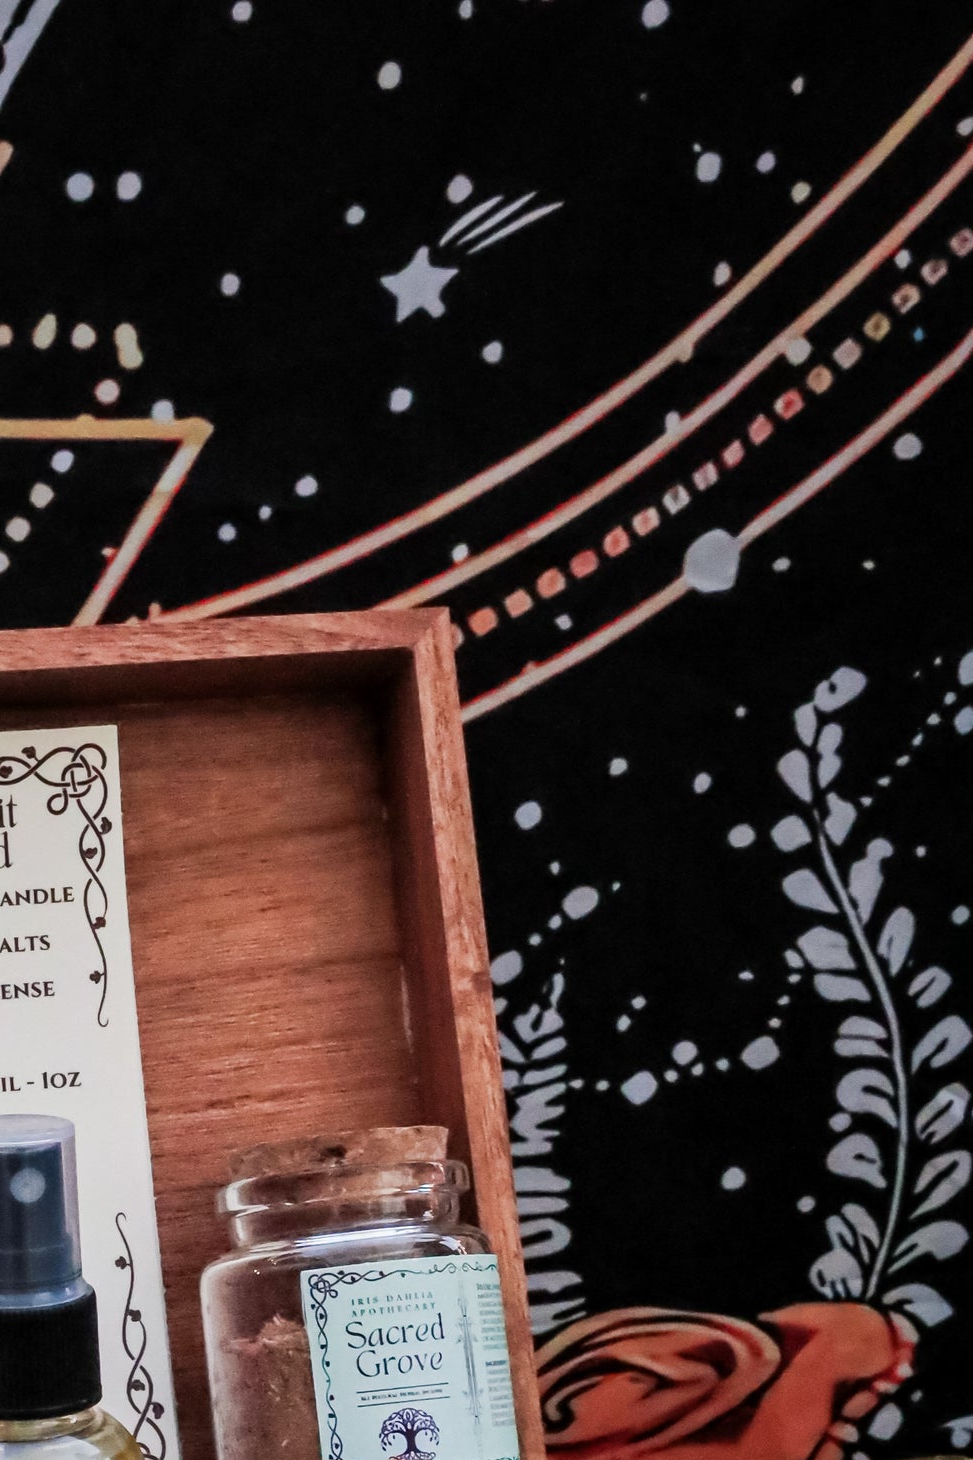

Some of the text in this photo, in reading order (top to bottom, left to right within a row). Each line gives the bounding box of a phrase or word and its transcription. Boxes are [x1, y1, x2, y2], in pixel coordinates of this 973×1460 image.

[351, 1291, 434, 1306] IRIS DAHLIA
[351, 1302, 436, 1318] APOTHECARY
[345, 1312, 445, 1349] Sacred
[356, 1350, 443, 1377] Grove
